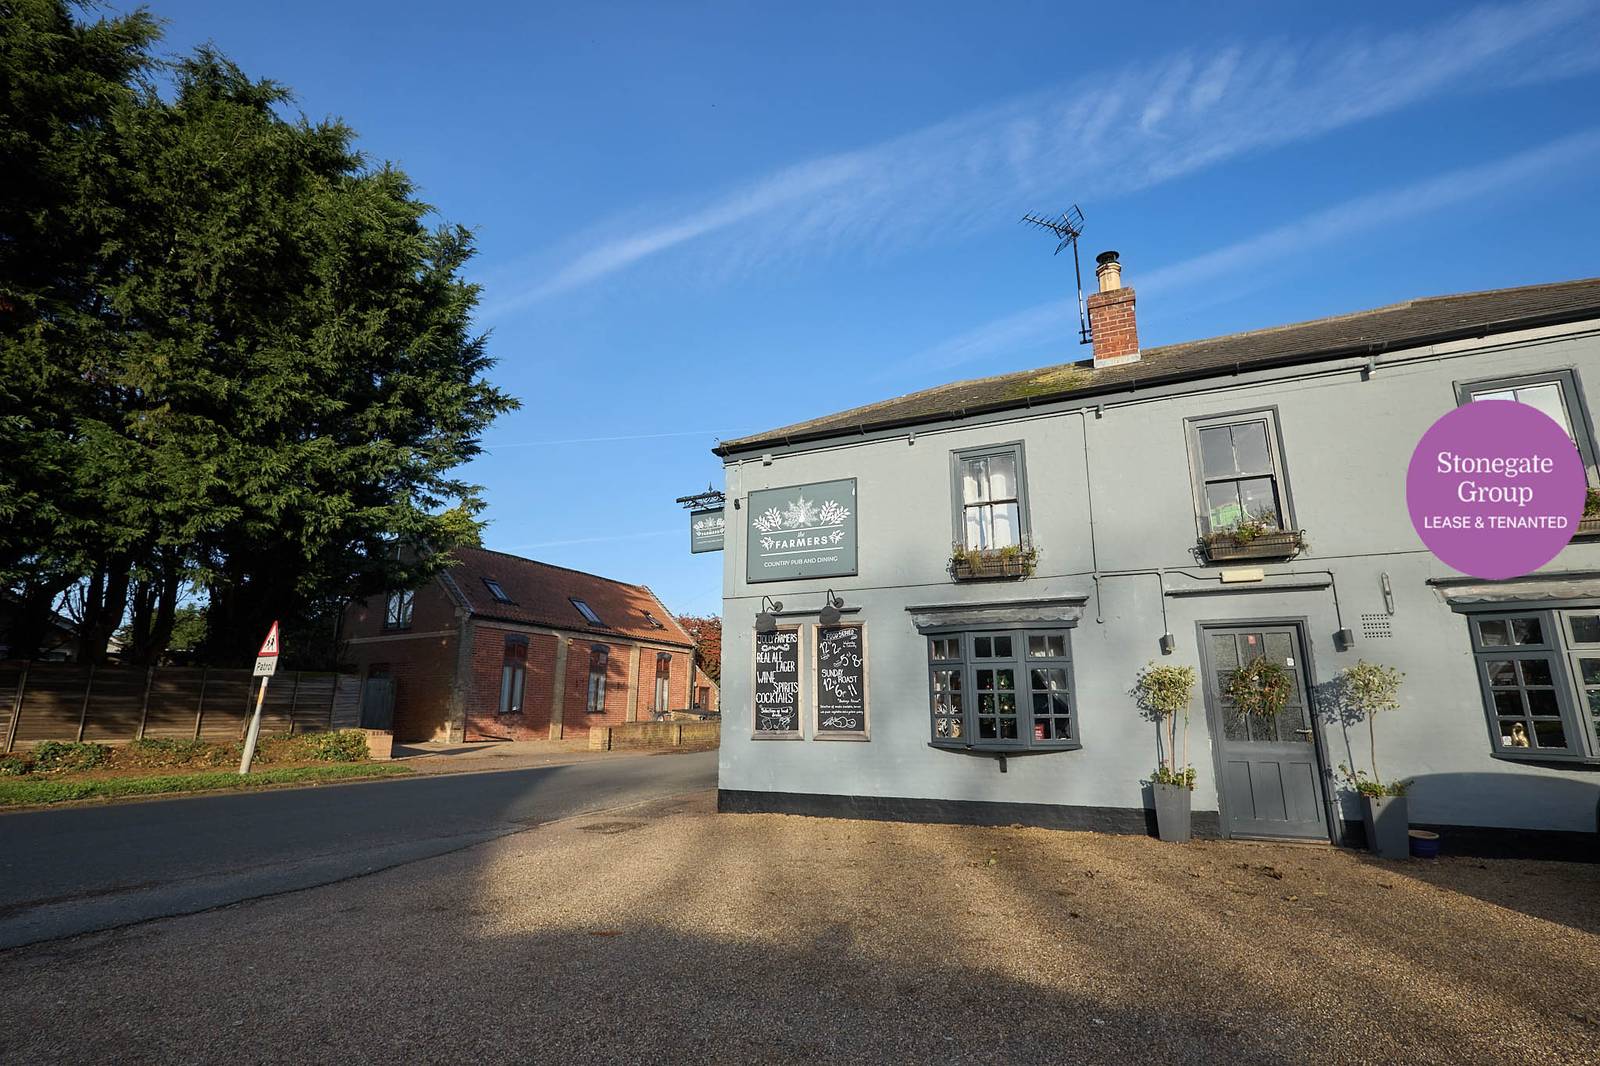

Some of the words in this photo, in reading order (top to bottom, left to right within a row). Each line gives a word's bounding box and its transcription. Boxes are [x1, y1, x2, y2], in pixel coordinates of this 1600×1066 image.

[775, 535, 828, 549] FARMERS
[763, 560, 790, 568] COUNTRY
[757, 634, 774, 644] JOLLY
[774, 632, 798, 644] FARMERS
[756, 651, 771, 663] REAL
[772, 651, 783, 663] ALE
[257, 662, 273, 671] Patrol
[776, 660, 796, 672] LAGER
[756, 670, 776, 684] WINE
[821, 668, 843, 677] SUNDAY
[838, 675, 858, 683] ROAST
[773, 682, 798, 693] SPIRITS
[756, 692, 793, 704] COCKTAILS
